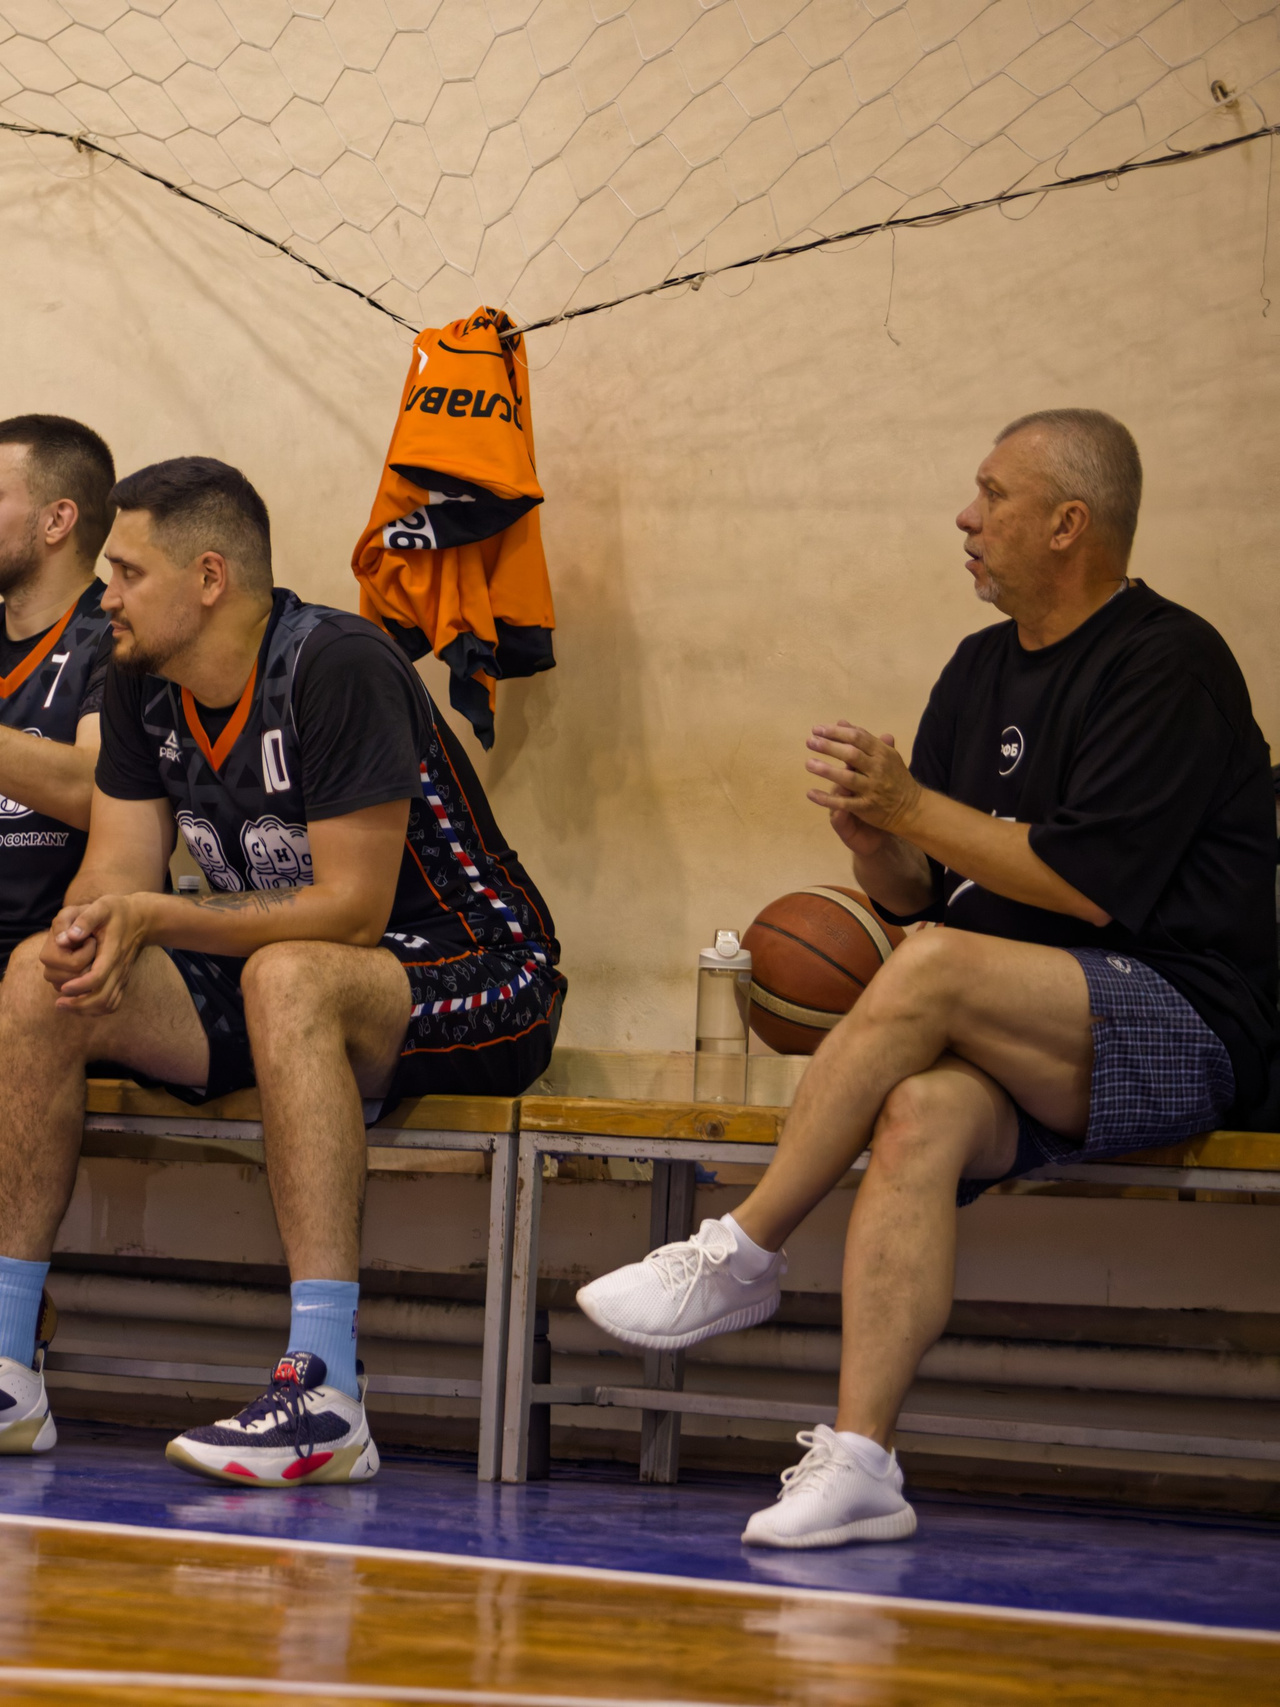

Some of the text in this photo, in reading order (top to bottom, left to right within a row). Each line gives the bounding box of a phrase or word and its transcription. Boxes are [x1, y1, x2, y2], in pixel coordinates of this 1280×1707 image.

[43, 651, 70, 709] 7
[261, 729, 291, 793] 10
[4, 832, 69, 847] COMPANY
[252, 841, 312, 867] CHO
